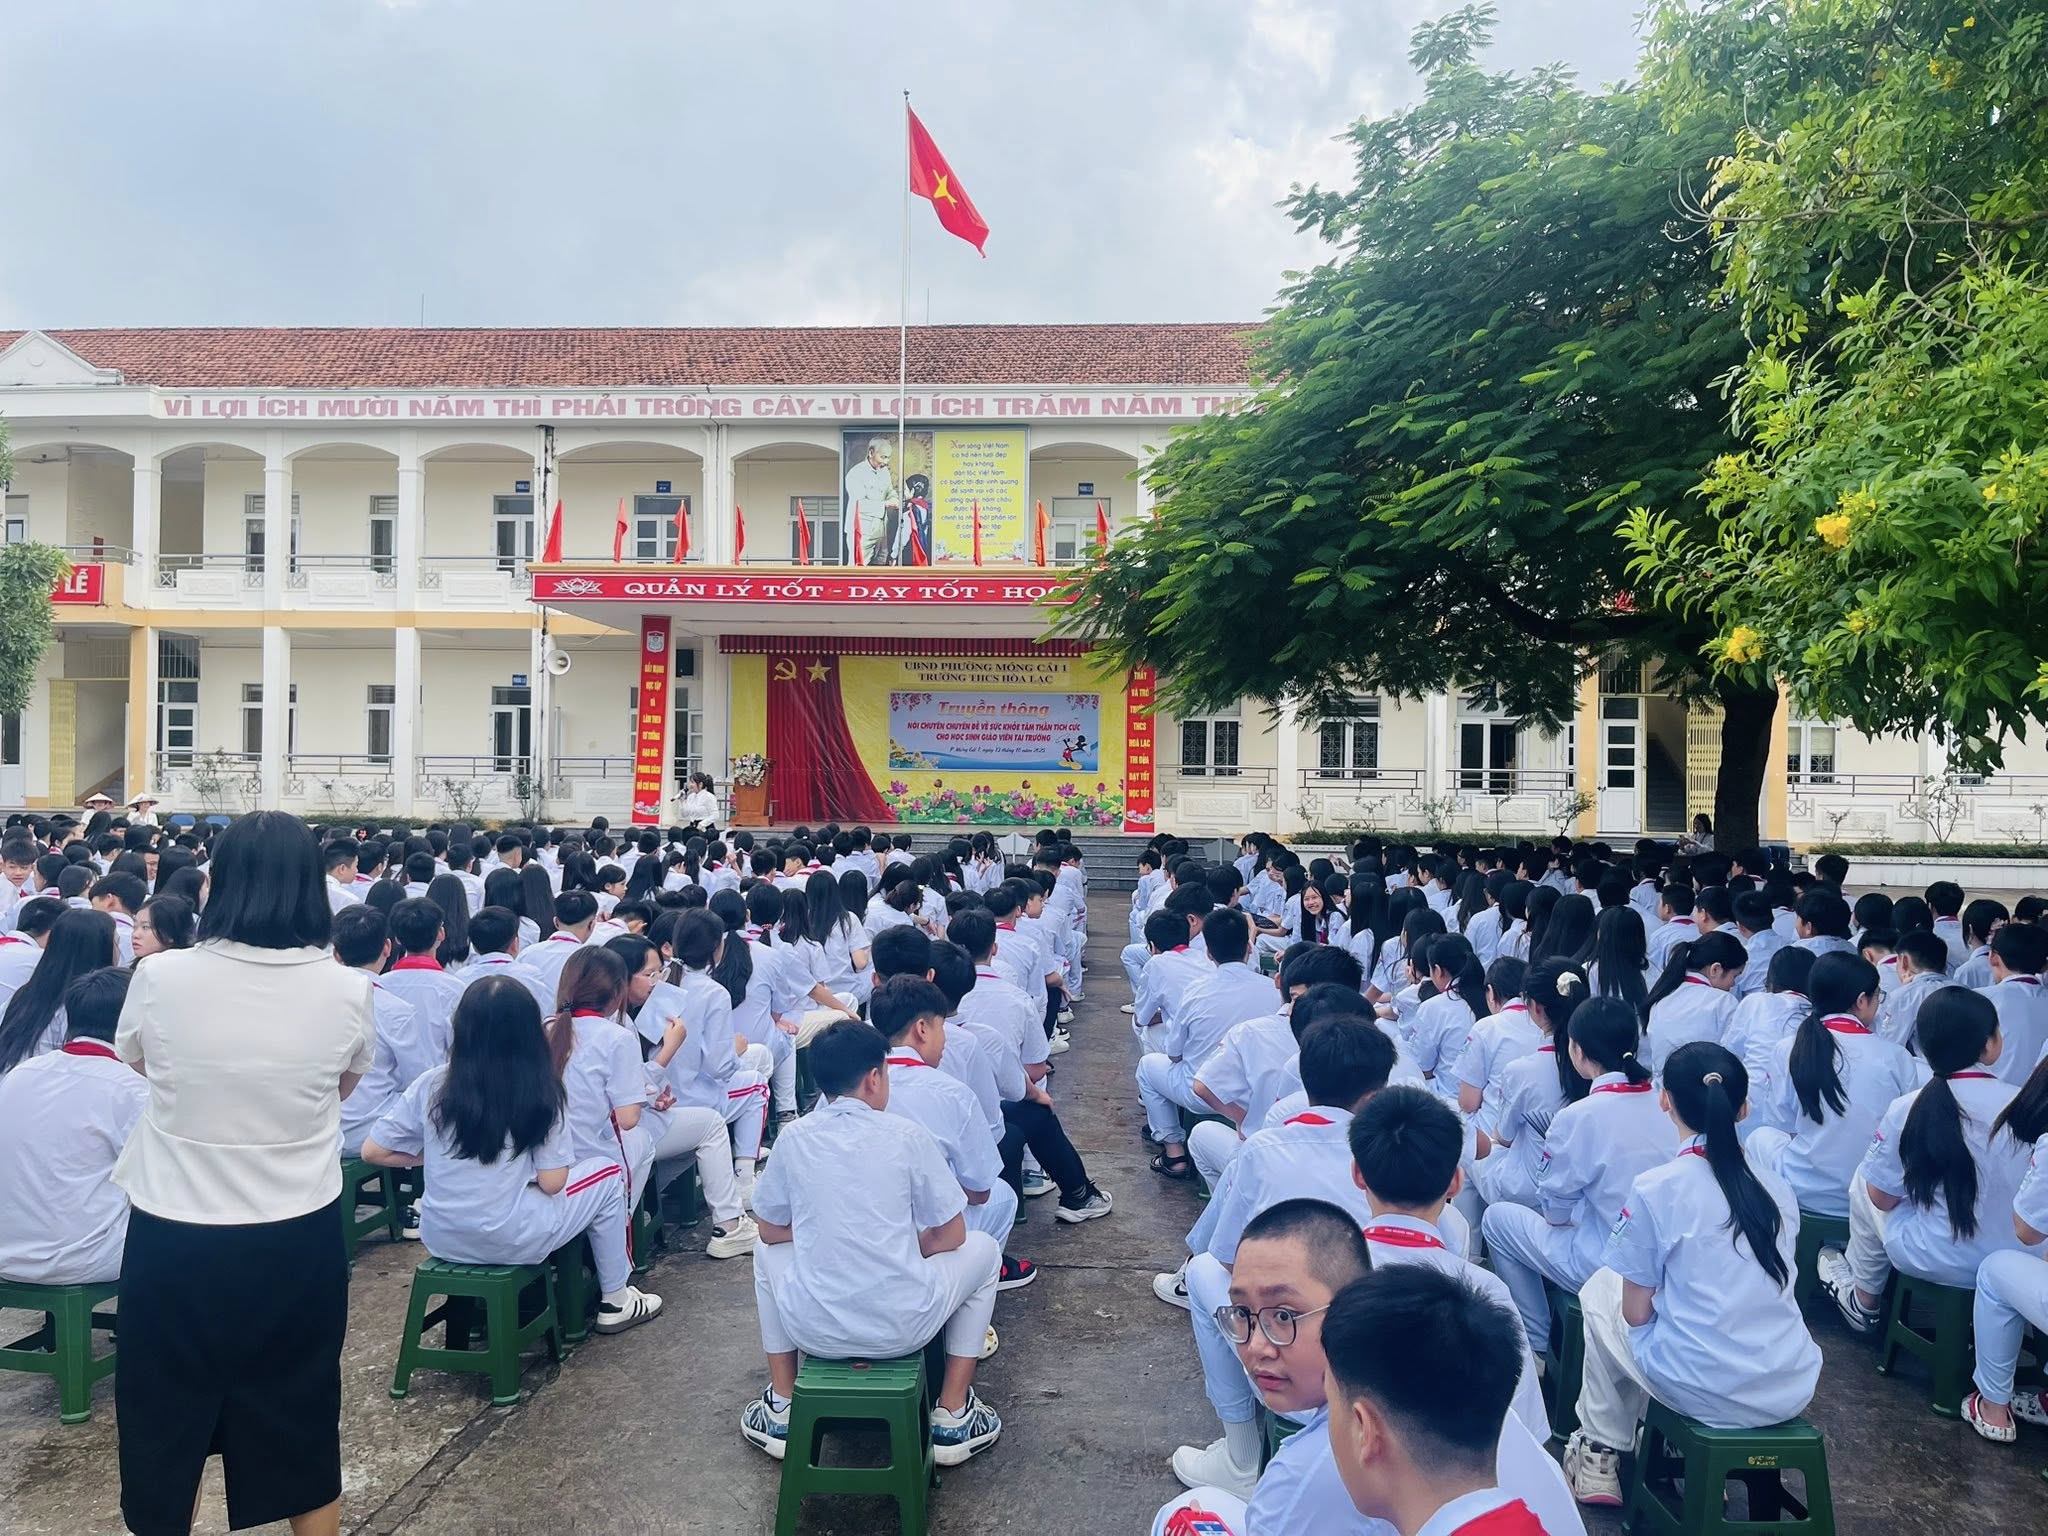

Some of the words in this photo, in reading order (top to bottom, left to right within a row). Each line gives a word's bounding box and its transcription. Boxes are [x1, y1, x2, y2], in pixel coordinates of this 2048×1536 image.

[164, 395, 192, 416] VÌ
[202, 399, 247, 420] LỢI
[258, 396, 307, 416] ÍCH
[318, 395, 398, 416] MƯỜI
[409, 394, 484, 416] NĂM
[493, 396, 541, 416] THÌ
[552, 394, 626, 416] PHẢI
[635, 394, 742, 416] TRỒNG
[753, 394, 813, 416] CÂY
[832, 393, 861, 416] VÌ
[873, 397, 921, 418] LỢI
[931, 393, 983, 416] ÍCH
[993, 394, 1090, 416] TRĂM
[1102, 393, 1182, 415] NĂM
[64, 567, 88, 593] LỄ
[624, 578, 706, 596] QUẢN
[715, 578, 753, 597] LÝ
[762, 577, 824, 598] TỐT
[848, 586, 912, 602] DẠY
[918, 579, 979, 599] TỐT
[905, 661, 938, 670] UBND
[941, 660, 992, 671] PHƯỜNG
[996, 660, 1033, 672] MÓNG
[1036, 660, 1058, 672] CÁI
[918, 672, 966, 682] TRƯỜNG
[969, 674, 999, 682] THCS
[1002, 672, 1026, 683] HÒA
[1029, 675, 1054, 686] LẠC
[938, 699, 996, 718] Truyền
[1000, 702, 1050, 719] thông
[946, 721, 970, 730] CHUYÊN
[972, 720, 979, 730] ĐỀ
[981, 720, 988, 730] VỀ
[990, 721, 1002, 731] SỨC
[1021, 721, 1035, 731] TÂM
[1036, 720, 1052, 731] THẦN
[1133, 722, 1147, 731] THCS
[951, 733, 964, 742] HỌC
[965, 733, 980, 741] SINH
[981, 732, 998, 741] GIÁO
[999, 733, 1013, 741] VIÊN
[1025, 733, 1051, 742] TRƯỜNG
[1140, 739, 1151, 749] LẠC
[1130, 755, 1138, 765] THI
[1129, 772, 1139, 782] DẠY
[1140, 770, 1150, 781] TỐT
[1129, 789, 1139, 799] HỌC
[1140, 786, 1150, 798] TỐT
